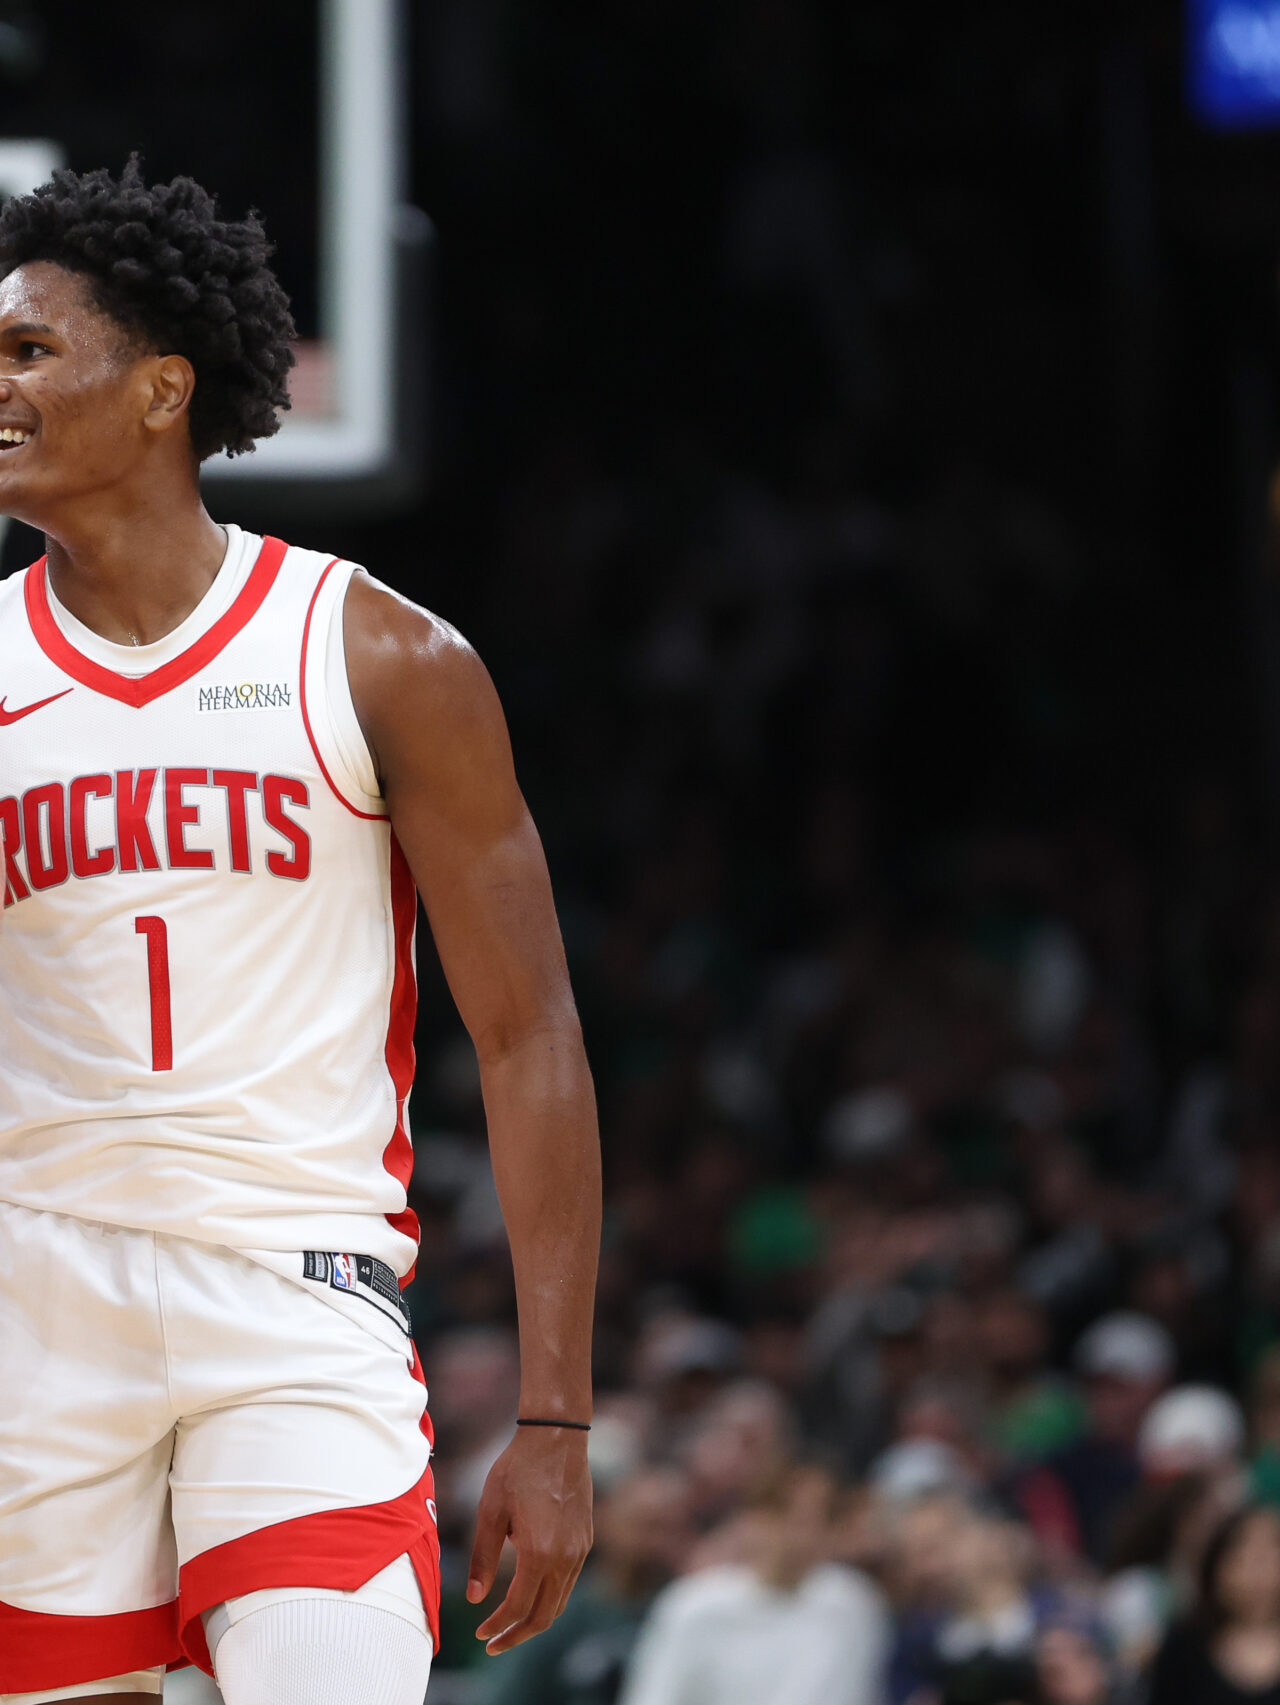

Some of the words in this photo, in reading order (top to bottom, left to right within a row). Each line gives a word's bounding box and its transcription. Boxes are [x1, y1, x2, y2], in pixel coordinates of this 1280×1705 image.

[199, 683, 291, 699] MEMORIAL
[199, 693, 291, 711] HERMANN
[134, 915, 173, 1072] 1
